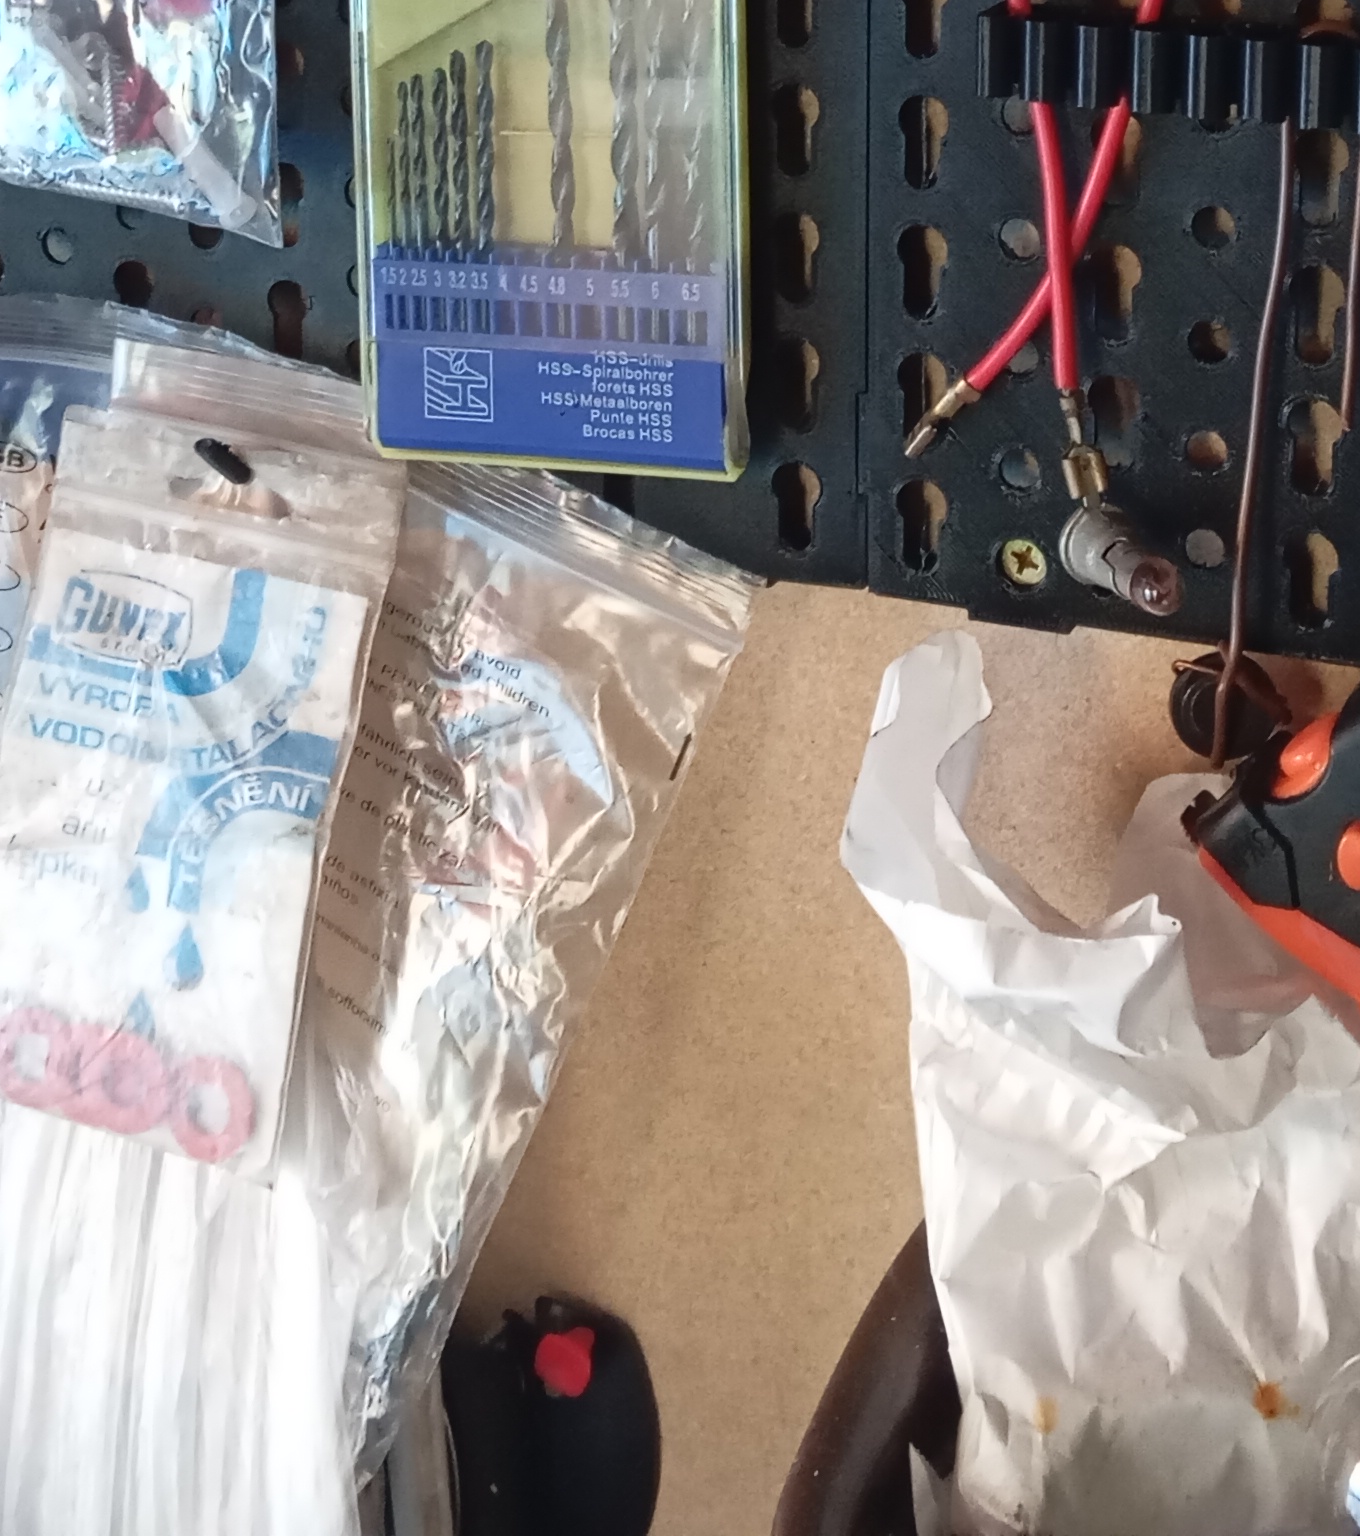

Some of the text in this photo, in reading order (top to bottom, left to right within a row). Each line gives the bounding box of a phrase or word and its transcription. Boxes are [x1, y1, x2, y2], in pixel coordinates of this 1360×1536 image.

[400, 268, 407, 286] 2
[433, 269, 441, 287] 3
[586, 278, 594, 296] 5
[651, 281, 660, 300] 6
[538, 361, 674, 383] HSS-Spiralbohrer
[640, 383, 673, 397] HSS
[590, 409, 672, 427] Punte HSS
[583, 424, 673, 443] Brocas HSS
[487, 671, 550, 718] children
